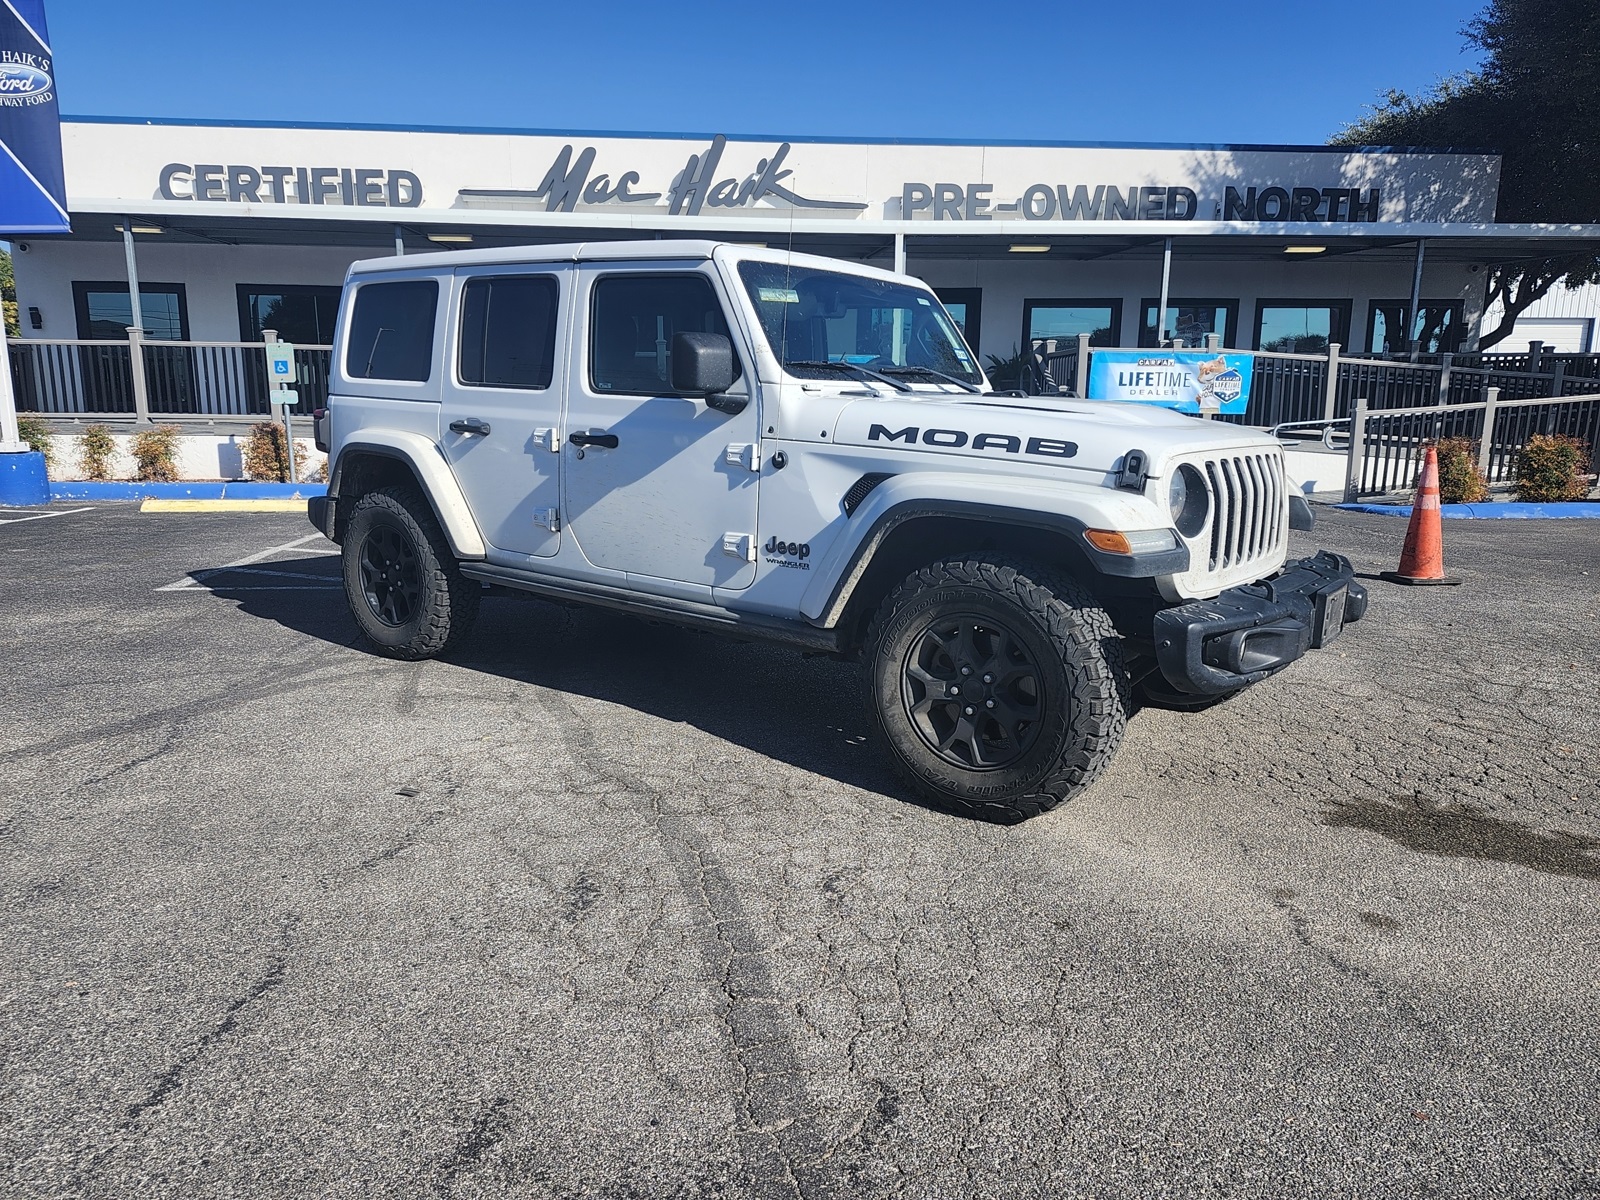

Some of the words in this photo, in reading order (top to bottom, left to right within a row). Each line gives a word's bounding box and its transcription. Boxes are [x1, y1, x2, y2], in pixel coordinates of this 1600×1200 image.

[1, 50, 51, 71] HAIK'S
[25, 92, 53, 106] FORD
[159, 162, 423, 208] CERTIFIED
[458, 144, 661, 212] Mac
[668, 133, 868, 216] Haik
[902, 182, 1197, 222] PRE-OWNED
[1223, 186, 1380, 223] NORTH
[1138, 358, 1175, 367] CARFAX
[1118, 371, 1192, 389] LIFETIME
[1129, 389, 1178, 397] DEALER
[867, 423, 1079, 459] MOAB
[765, 535, 811, 560] Jeep
[765, 557, 810, 568] WRANGLER
